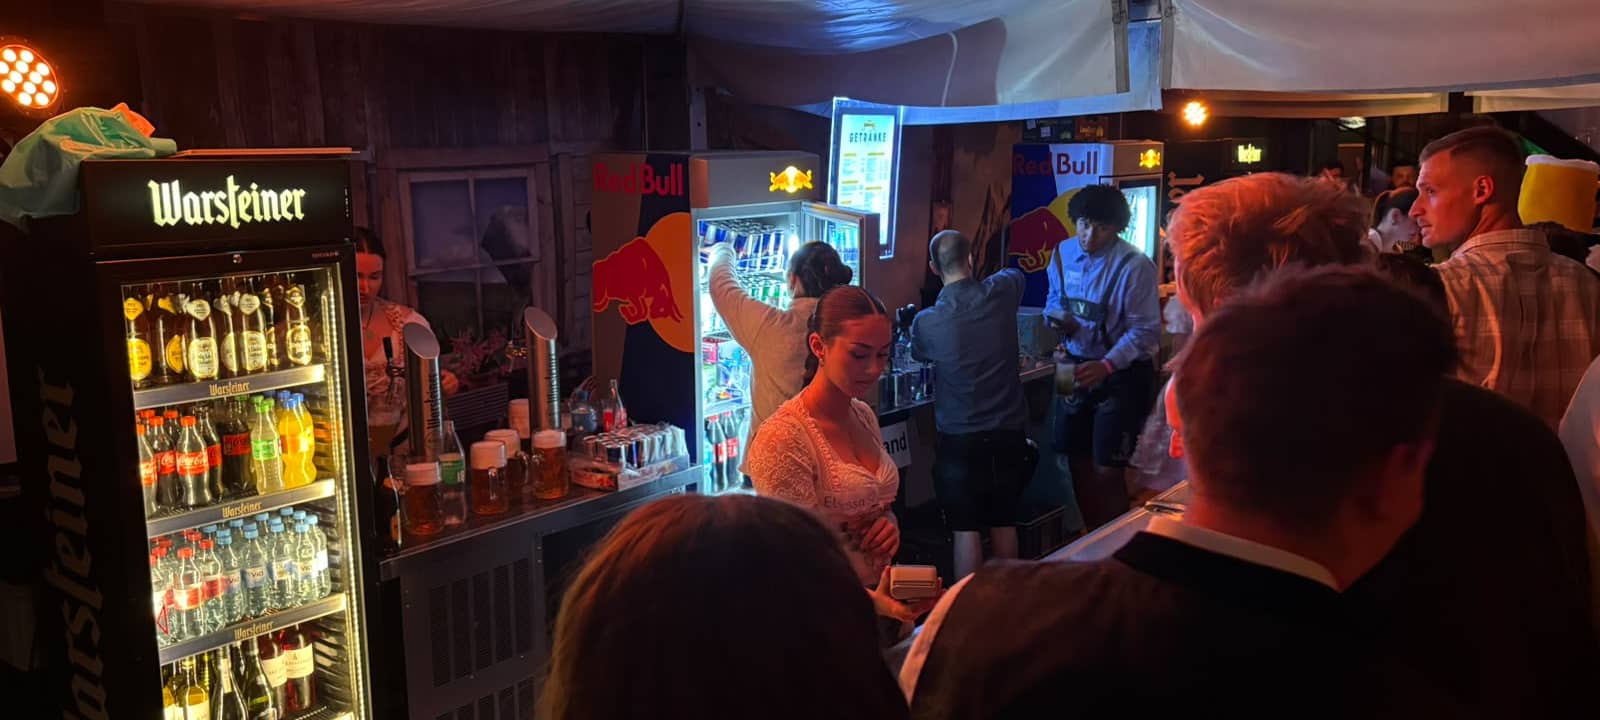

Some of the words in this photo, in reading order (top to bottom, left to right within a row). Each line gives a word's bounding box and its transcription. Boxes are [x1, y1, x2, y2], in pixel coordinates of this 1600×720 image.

[1013, 151, 1053, 176] Red
[1056, 150, 1099, 175] Bull
[593, 160, 637, 194] Red
[640, 160, 685, 197] Bull
[147, 174, 306, 230] Warsteiner
[208, 381, 250, 396] Warsteiner
[882, 431, 907, 455] and
[222, 500, 262, 518] Warsteiner
[233, 620, 274, 641] Warsteiner
